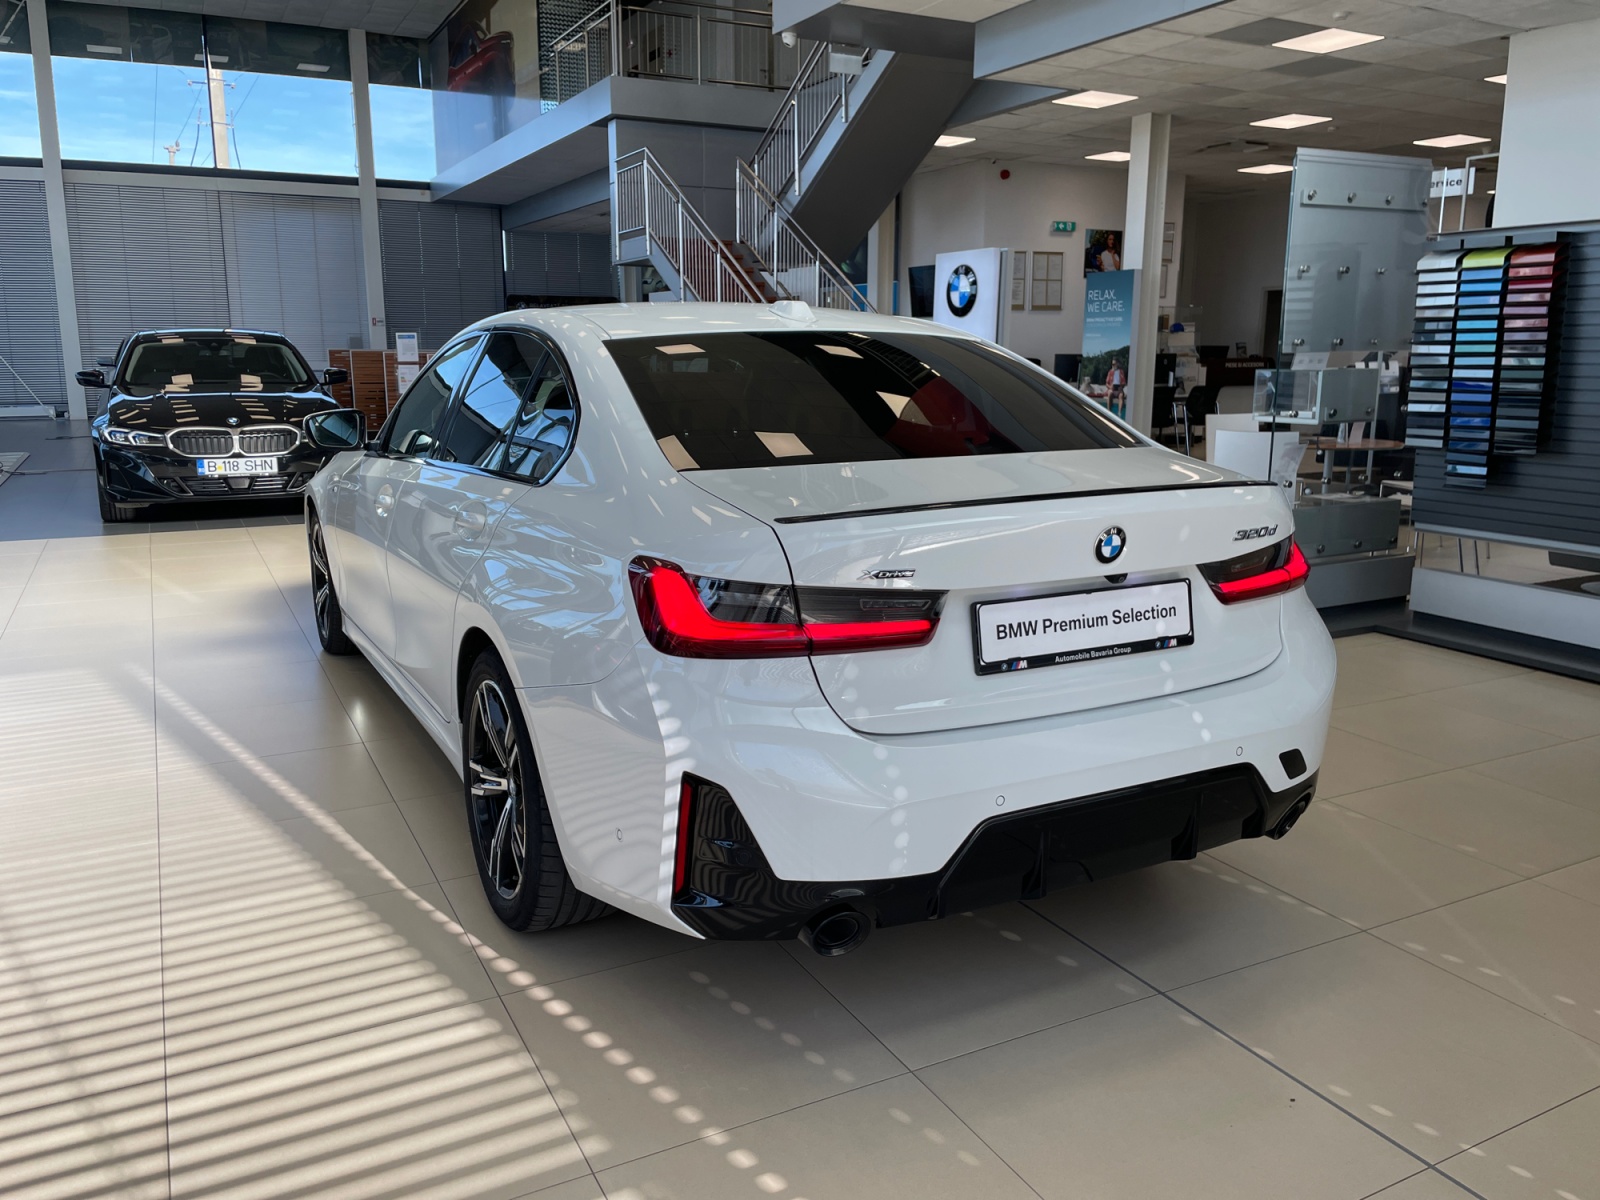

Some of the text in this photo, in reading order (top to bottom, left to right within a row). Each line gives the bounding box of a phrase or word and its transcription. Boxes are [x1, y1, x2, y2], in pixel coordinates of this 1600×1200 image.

[1431, 178, 1462, 189] ervice
[1087, 289, 1117, 301] RELAX.
[1087, 300, 1125, 313] WE CARE.
[207, 459, 273, 472] B 118 SHN
[1232, 524, 1278, 541] 320d
[996, 604, 1177, 640] BMW Premium Selection
[1055, 646, 1132, 663] Automobile Bavaria Group
